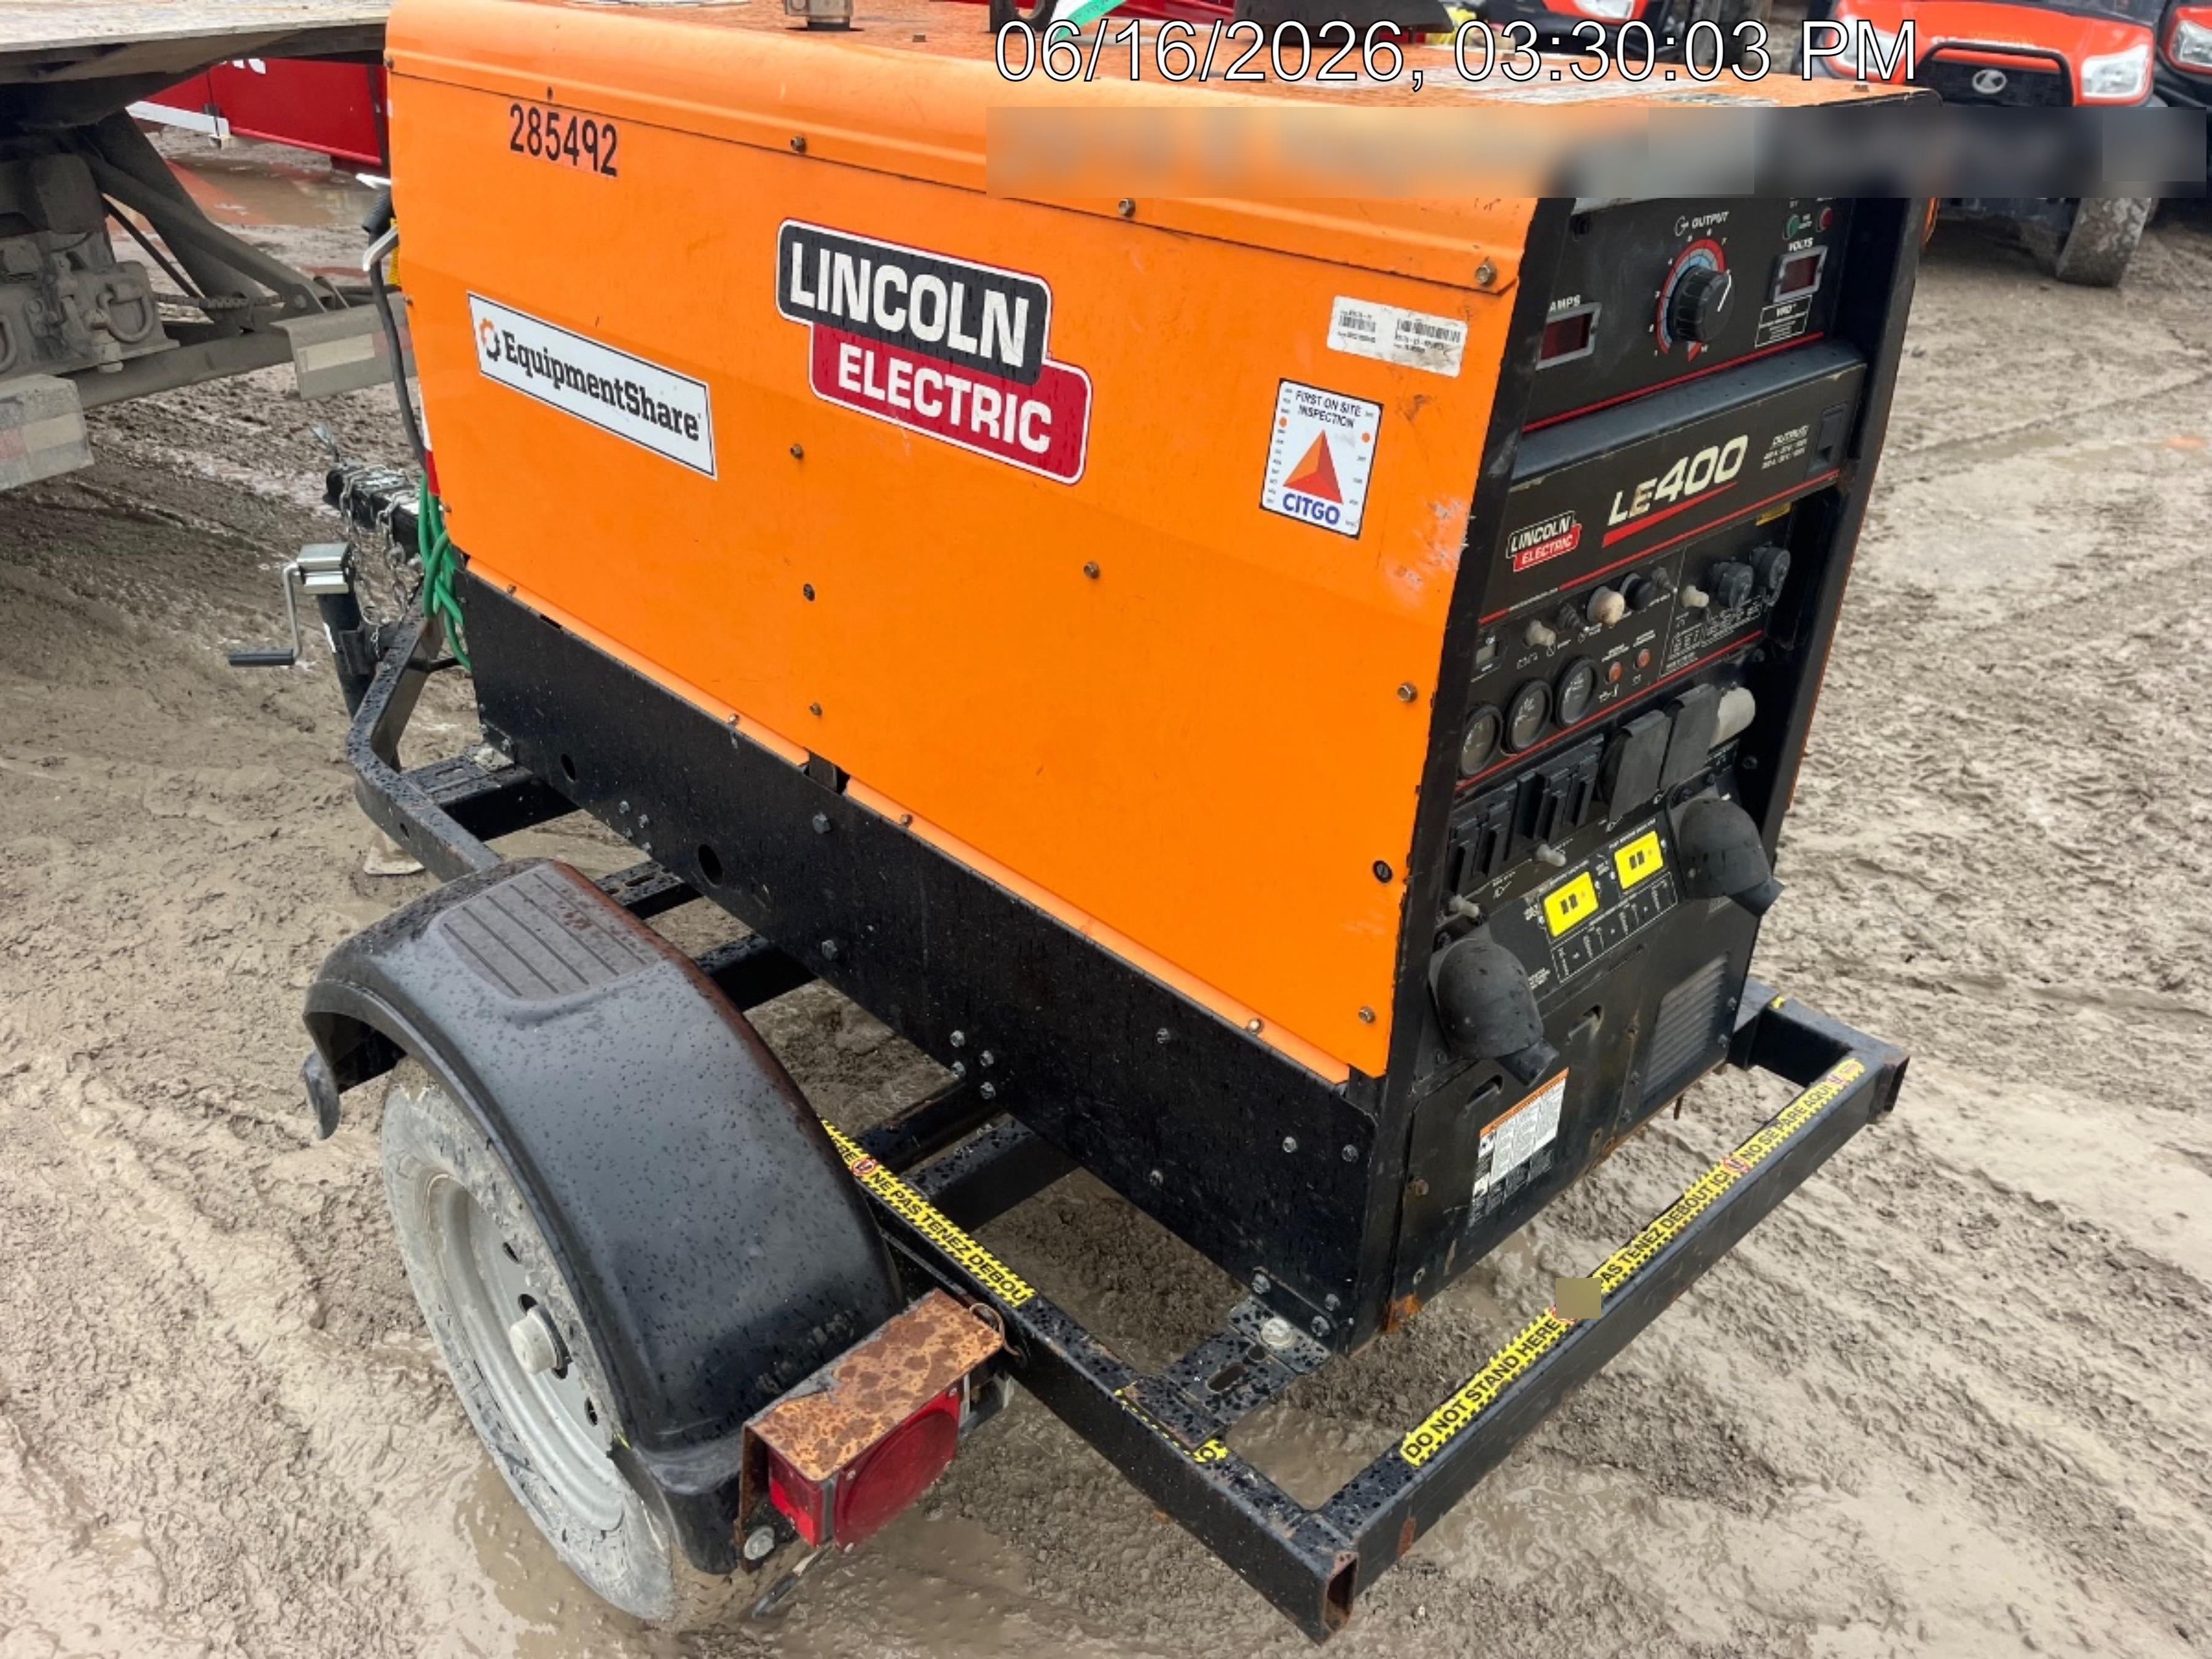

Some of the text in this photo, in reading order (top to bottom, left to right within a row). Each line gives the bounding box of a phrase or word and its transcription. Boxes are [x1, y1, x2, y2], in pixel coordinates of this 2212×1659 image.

[509, 103, 618, 177] 285492
[1692, 211, 1730, 229] OUTPUT
[790, 241, 1029, 367] LINCOLN
[501, 329, 700, 442] EquipmentShare
[837, 342, 1052, 453] ELECTRIC
[1298, 405, 1355, 428] INSPECTION
[1324, 398, 1339, 410] ON
[1339, 401, 1362, 417] SITE
[1282, 492, 1341, 525] CITGO
[1510, 516, 1572, 553] LINCOLN
[1521, 533, 1574, 565] ELECTRIC
[1739, 1143, 1763, 1160] NO
[1758, 1128, 1779, 1145] SE
[1775, 1105, 1808, 1132] PARE
[869, 1171, 895, 1191] NE
[890, 1189, 922, 1215] PAS
[924, 1213, 972, 1255] TENEZ
[1599, 1264, 1623, 1284] AS
[1618, 1227, 1666, 1263] TENEZ
[1659, 1183, 1714, 1230] DEBOUT
[1403, 1319, 1560, 1459] DO NOT STAND HERE
